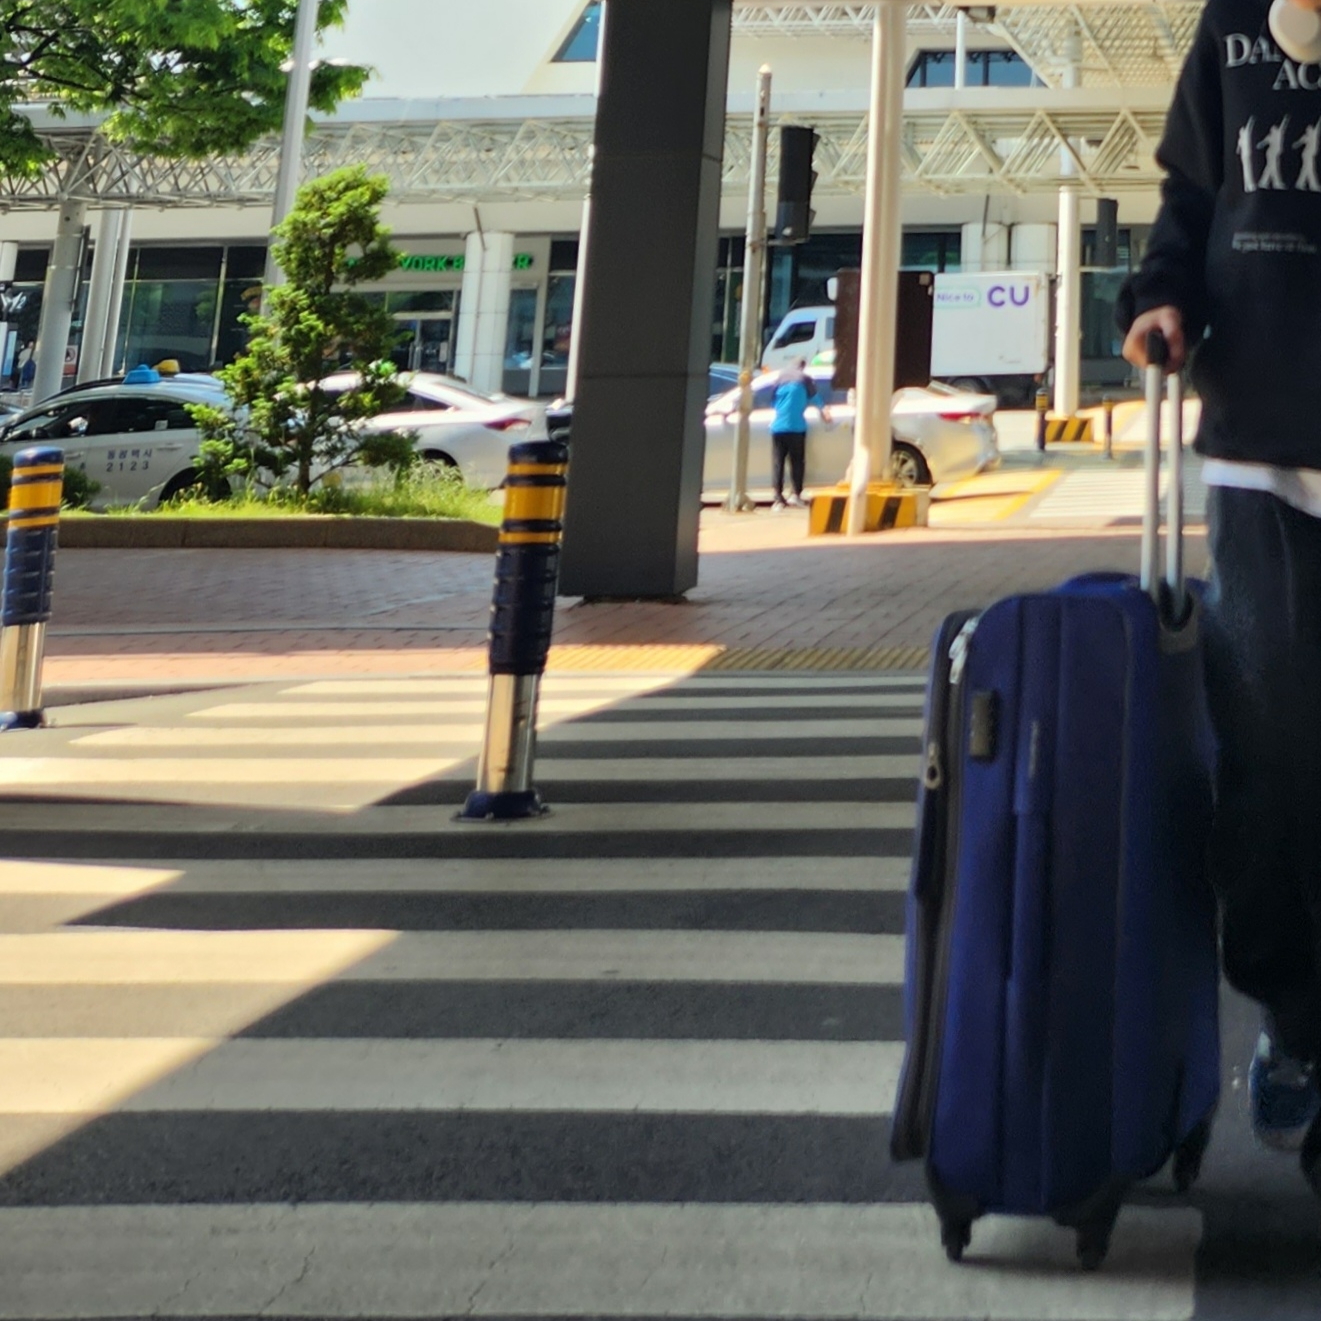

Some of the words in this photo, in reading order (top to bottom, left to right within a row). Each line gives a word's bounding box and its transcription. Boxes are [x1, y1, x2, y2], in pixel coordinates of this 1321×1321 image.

[401, 255, 449, 271] YORK
[988, 285, 1029, 307] CU
[106, 460, 149, 472] 2123
